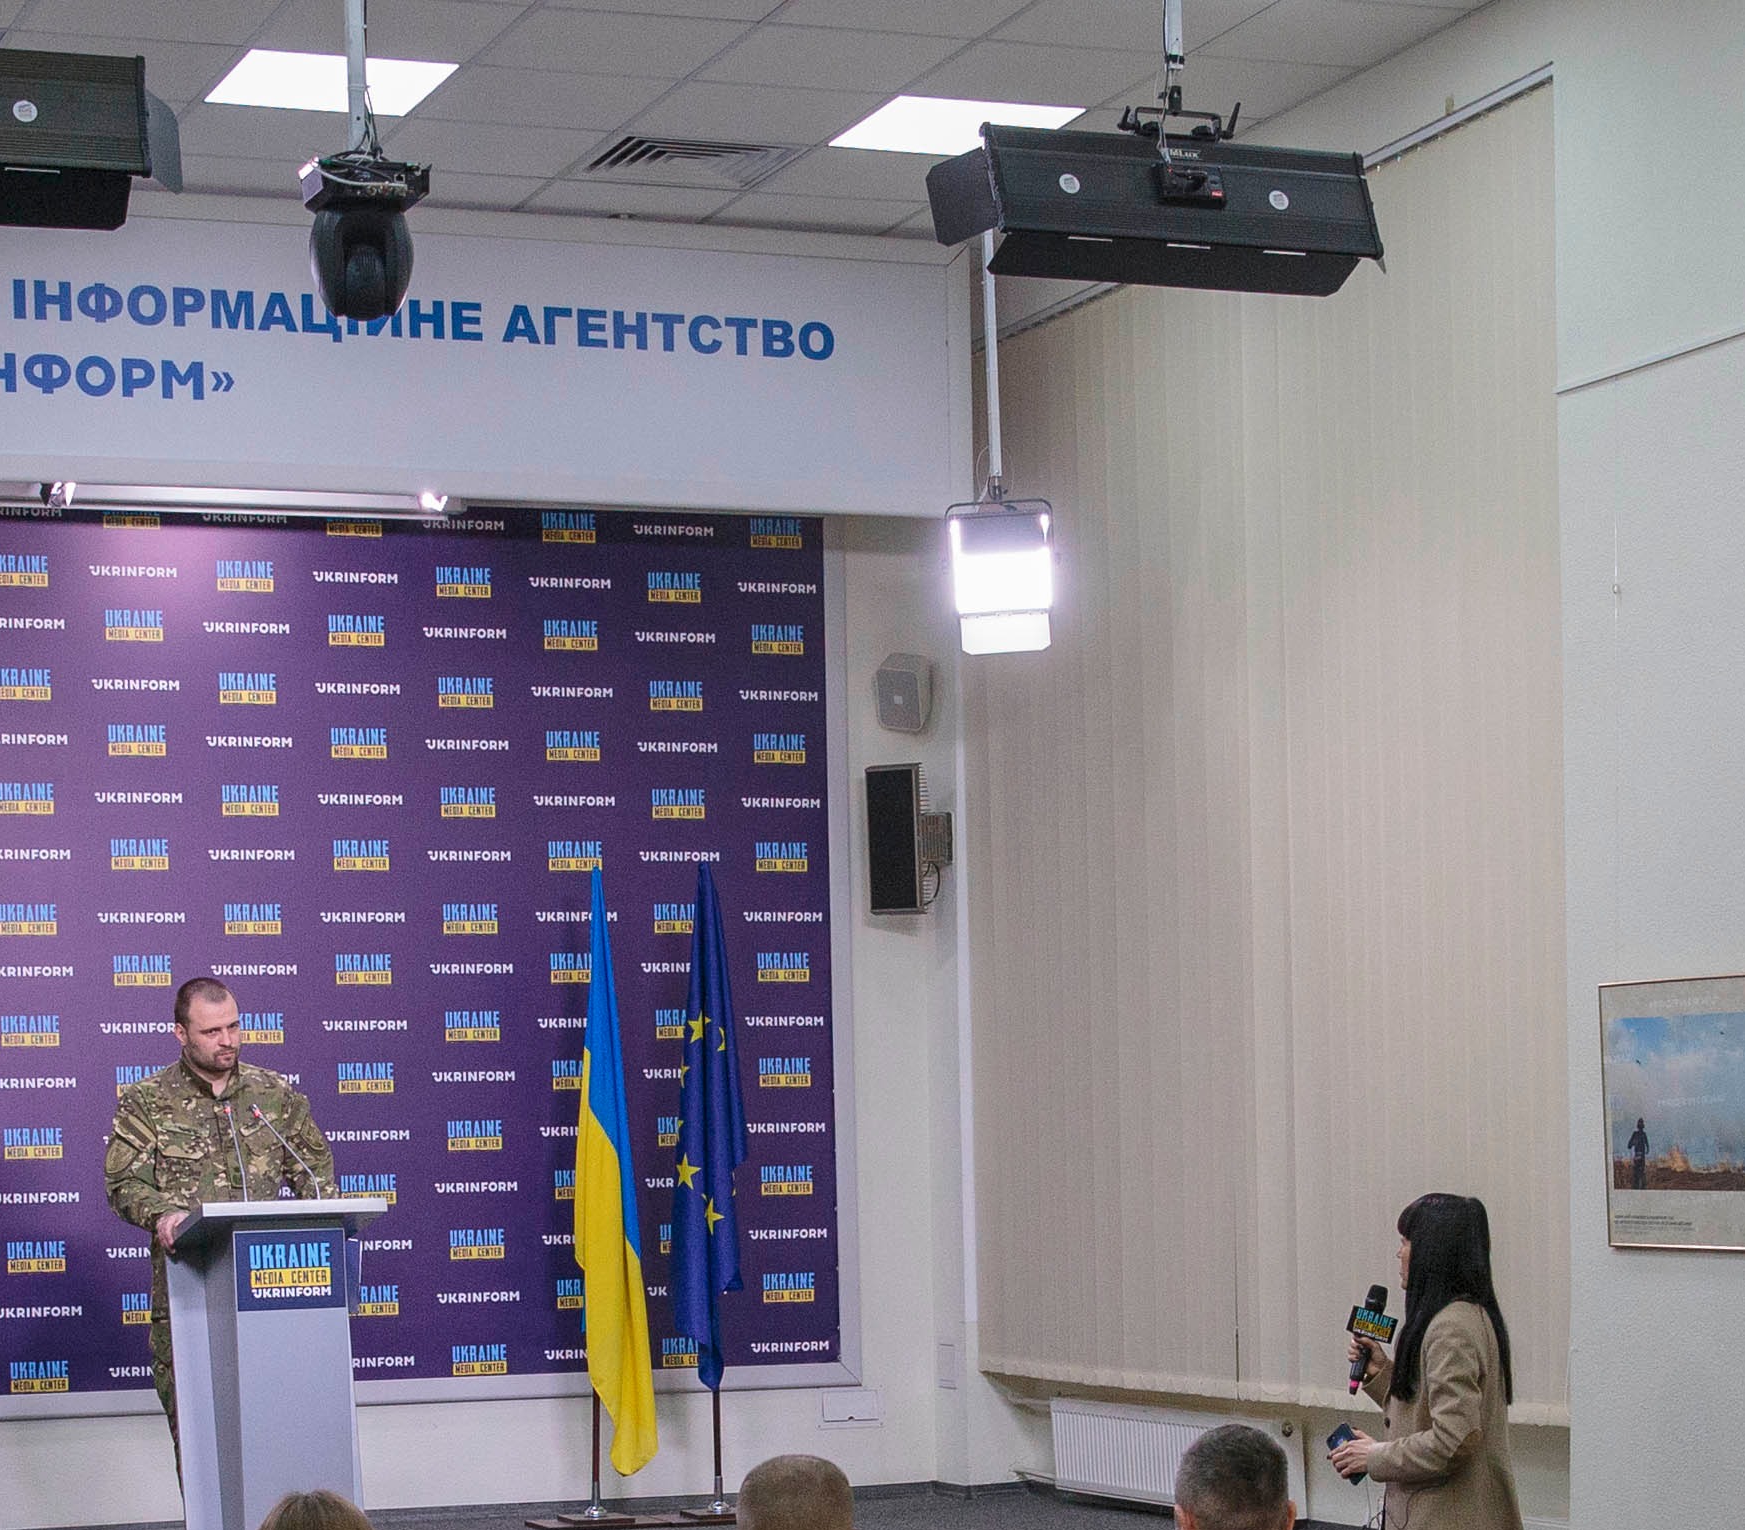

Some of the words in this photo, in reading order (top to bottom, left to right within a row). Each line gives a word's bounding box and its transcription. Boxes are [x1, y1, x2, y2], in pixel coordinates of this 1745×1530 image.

[503, 304, 835, 361] АГЕНТСТВО
[634, 525, 713, 536] UKRINFORM
[19, 571, 46, 585] CENTER
[89, 566, 176, 577] UKRINFORM
[648, 573, 700, 589] UKRAINE
[650, 589, 670, 601] MEDIA
[675, 590, 699, 601] CENTER
[203, 622, 290, 634] UKRINFORM
[328, 615, 384, 631] UKRAINE
[331, 631, 352, 645] MEDIA
[357, 632, 383, 645] CENTER
[423, 627, 507, 639] UKRINFORM
[315, 683, 400, 695] UKRINFORM
[531, 686, 613, 698] UKRINFORM
[739, 690, 818, 701] UKRINFORM
[95, 792, 182, 803] UKRINFORM
[112, 840, 168, 854] UKRAINE
[334, 840, 388, 855] UKRAINE
[113, 854, 135, 868] MEDIA
[140, 855, 167, 868] CENTER
[208, 849, 295, 860] UKRINFORM
[427, 850, 511, 861] UKRINFORM
[336, 855, 357, 869] MEDIA
[361, 856, 387, 869] CENTER
[97, 912, 185, 923] UKRINFORM
[320, 912, 405, 922] UKRINFORM
[757, 952, 809, 968] UKRAINE
[759, 968, 779, 980] MEDIA
[783, 968, 808, 980] CENTER
[745, 1016, 824, 1026] UKRINFORM
[432, 1071, 515, 1082] UKRINFORM
[447, 1120, 502, 1136] UKRAINE
[4, 1128, 62, 1144] UKRAINE
[450, 1136, 471, 1149] MEDIA
[475, 1137, 501, 1149] CENTER
[6, 1144, 28, 1158] MEDIA
[33, 1145, 61, 1158] CENTER
[249, 1242, 330, 1269] UKRAINE
[255, 1271, 284, 1285] MEDIA
[291, 1269, 327, 1283] CENTER
[763, 1272, 814, 1288] UKRAINE
[251, 1286, 332, 1299] UKRINFORM
[437, 1291, 520, 1304] UKRINFORM
[765, 1288, 785, 1301] MEDIA
[789, 1289, 813, 1301] CENTER
[452, 1344, 506, 1363] UKRAINE
[751, 1341, 827, 1353] UKRINFORM
[10, 1361, 68, 1380] UKRAINE
[455, 1363, 475, 1374] MEDIA
[480, 1363, 505, 1374] CENTER
[13, 1380, 35, 1390] MEDIA
[39, 1380, 66, 1390] CENTER
